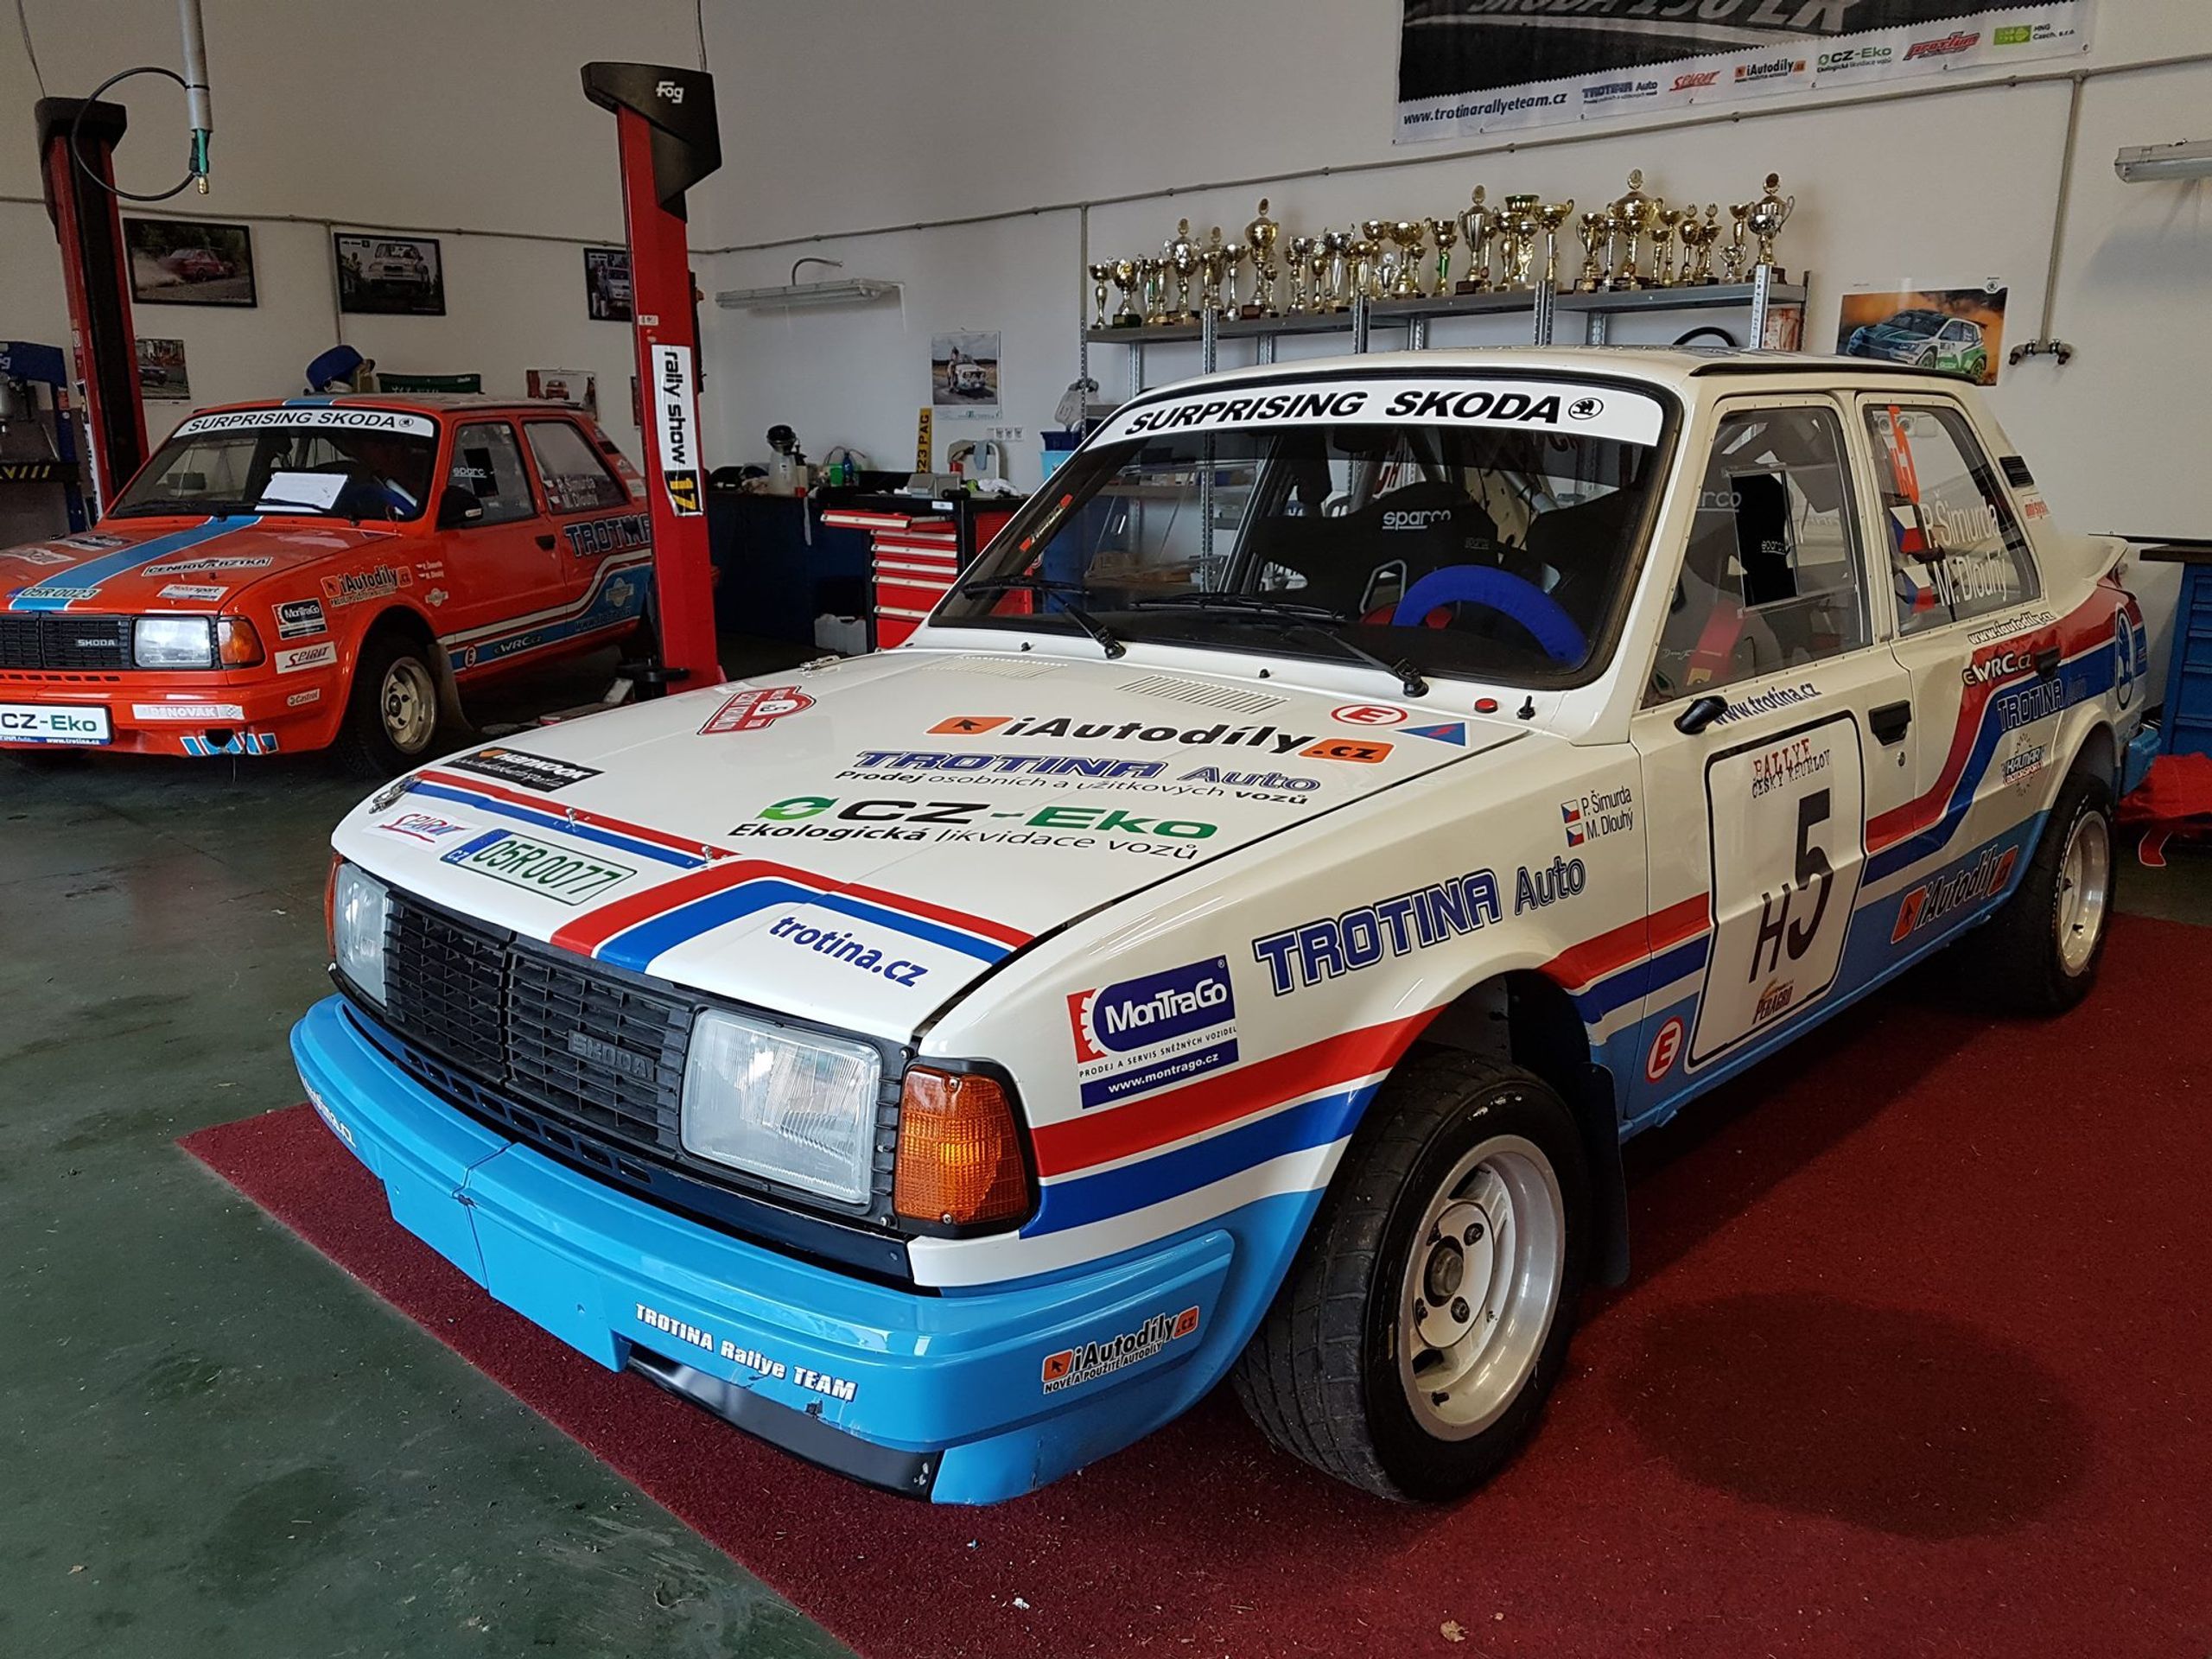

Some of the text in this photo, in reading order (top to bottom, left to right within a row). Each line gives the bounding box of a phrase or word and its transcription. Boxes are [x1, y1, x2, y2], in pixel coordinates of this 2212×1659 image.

[1830, 47, 1891, 63] CZ-Eko
[1635, 79, 1658, 92] Auto
[1403, 92, 1568, 125] www.trotinarallyeteam.cz
[188, 411, 396, 433] SURPRISING SKODA
[663, 351, 697, 511] rally show 17
[1124, 390, 1561, 435] SURPRISING SKODA
[1919, 490, 2001, 550] P. Šimurda
[1932, 550, 2007, 607] M. Dlouhý
[77, 639, 116, 647] SKODA
[285, 645, 330, 669] SPIRIT
[1961, 650, 2032, 687] eWRC.cz
[1, 712, 98, 732] CZ-Eko
[1996, 677, 2065, 732] TROTINA
[834, 771, 1310, 805] Prodej osobních a užitkových vozů
[853, 749, 1322, 792] TROTINA Auto
[836, 799, 1218, 841] CZ-Eko
[1580, 785, 1633, 817] P. Šimurda
[727, 823, 1201, 861] Ekologická likvidace vozů
[1586, 806, 1634, 841] M. Dlouhý
[447, 849, 466, 861] CZ
[1252, 856, 1587, 997] TROTINA Auto
[770, 914, 930, 988] trotina.cz
[1104, 977, 1228, 1035] MonTraGo
[1079, 1063, 1114, 1078] PRODEJ
[1117, 1059, 1124, 1068] A
[1127, 1051, 1158, 1065] SERVIS
[1205, 1025, 1237, 1042] VOZIDEL
[1108, 1052, 1219, 1094] www.montrago.cz
[635, 1302, 859, 1402] TROTINA Rallye TEAM
[1044, 1340, 1163, 1395] NOVÉ A POUŽITÉ AUTODÍLY
